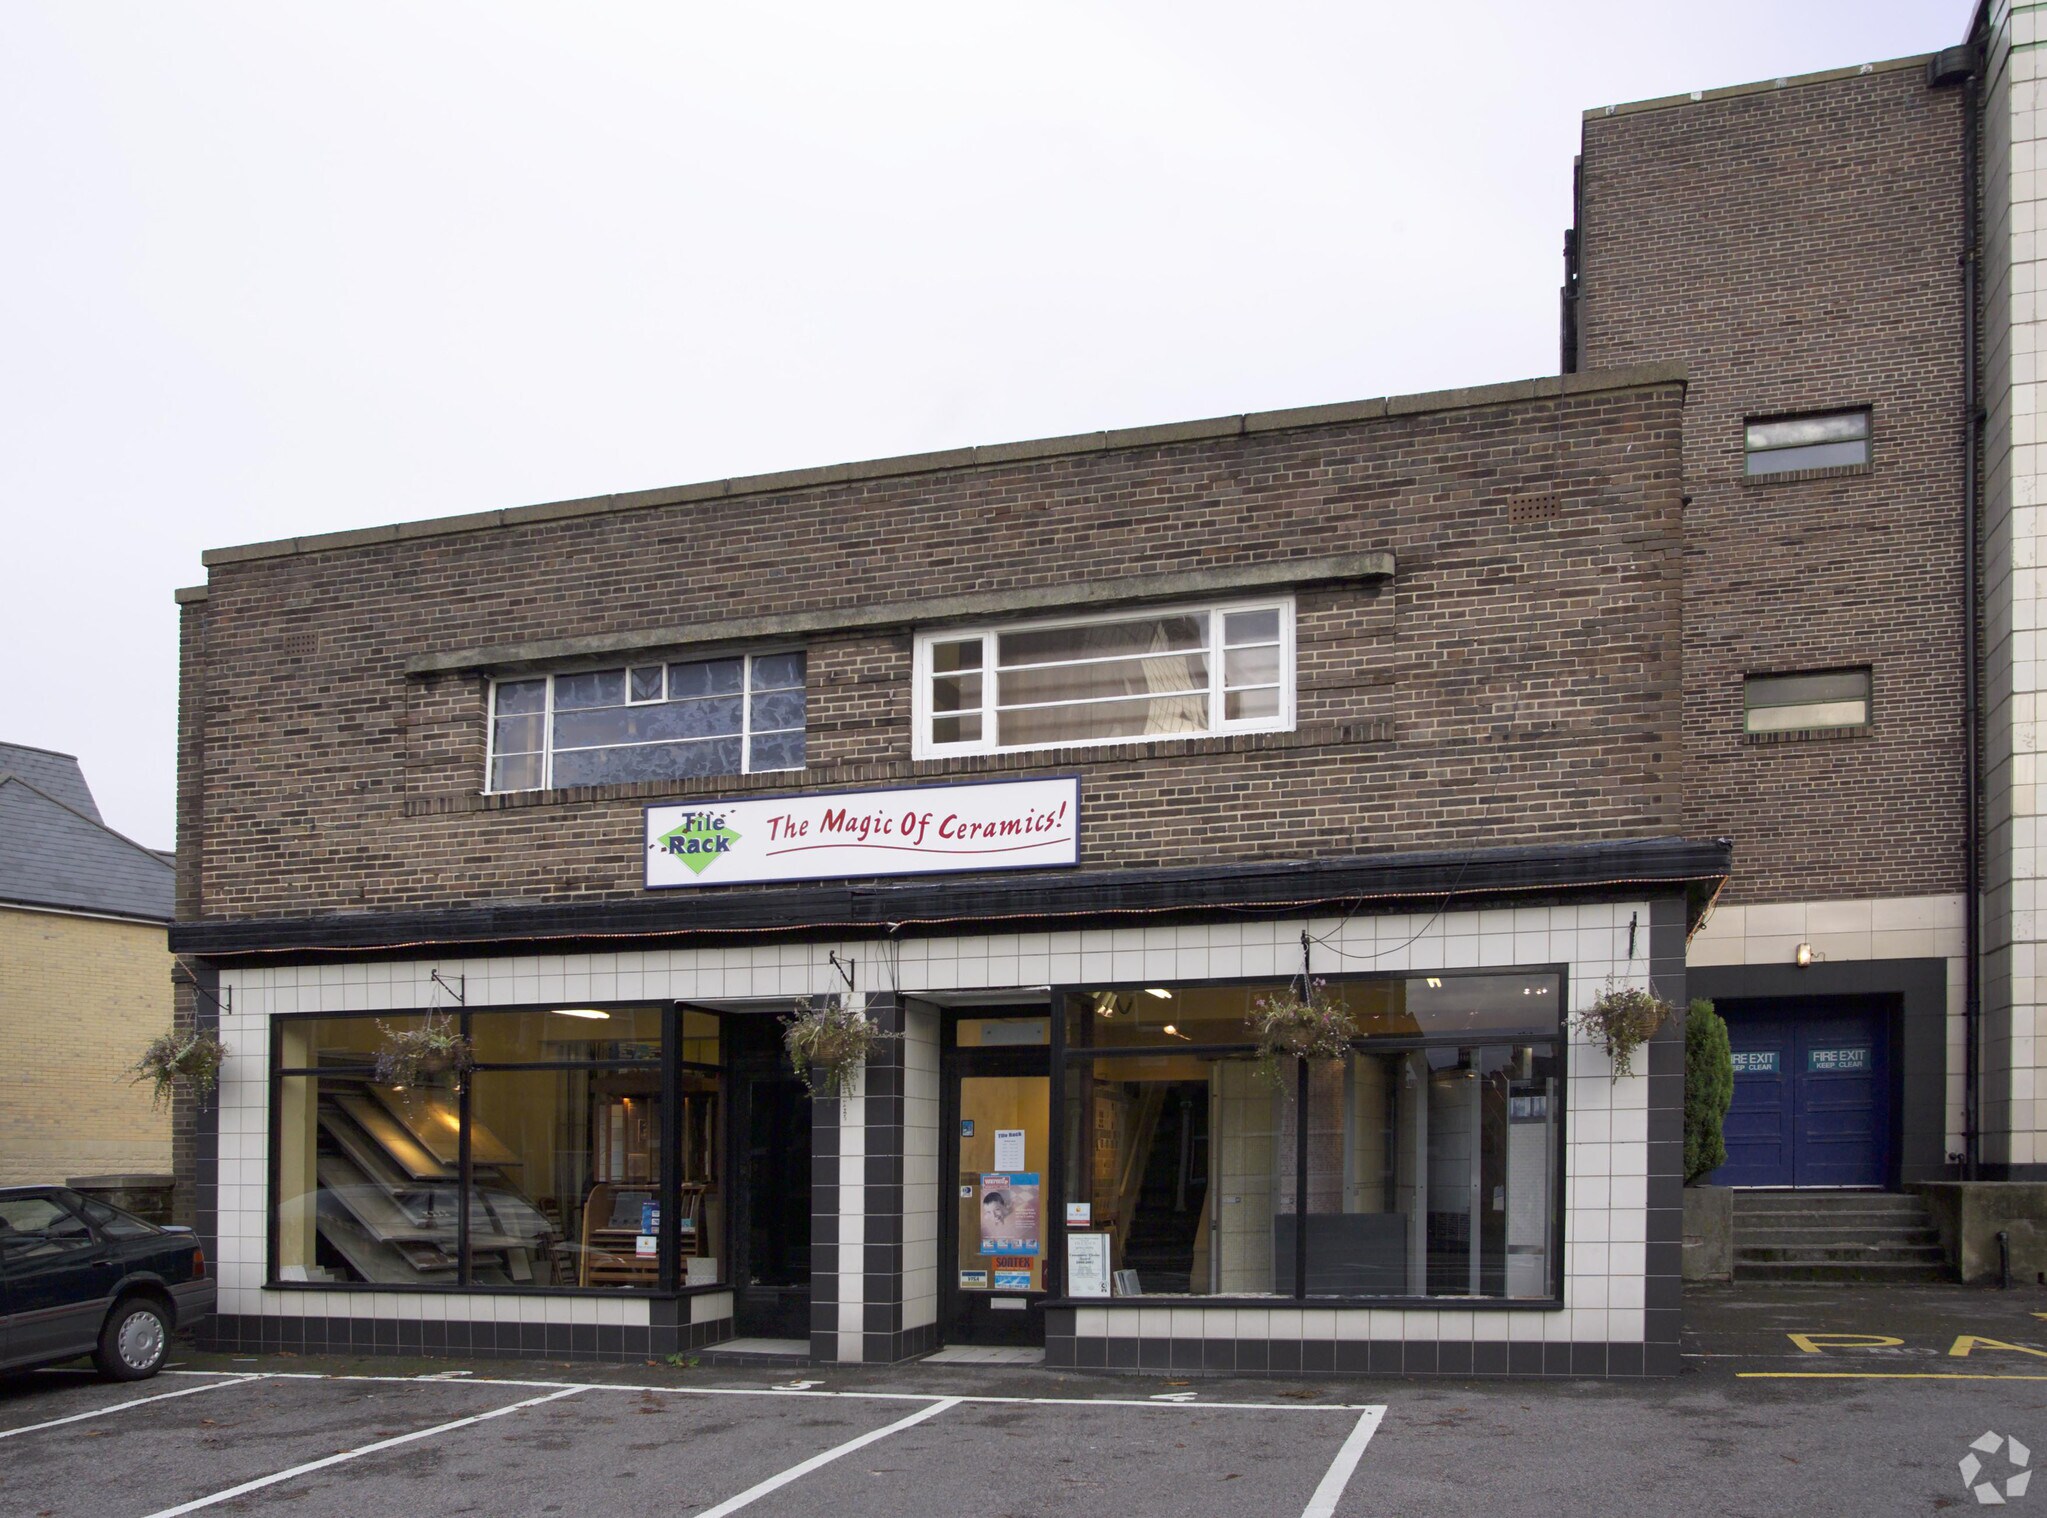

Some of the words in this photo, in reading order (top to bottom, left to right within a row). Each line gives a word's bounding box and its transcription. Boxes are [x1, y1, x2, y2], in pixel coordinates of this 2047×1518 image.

[682, 811, 725, 832] Tile
[766, 813, 808, 841] The
[819, 808, 893, 841] Magic
[900, 811, 933, 845] Of
[938, 800, 1067, 839] Ceramics!
[669, 834, 730, 854] Rack
[1731, 1053, 1747, 1064] IRE
[1750, 1053, 1775, 1063] EXIT
[1813, 1051, 1838, 1062] FIRE
[1839, 1050, 1865, 1061] EXIT
